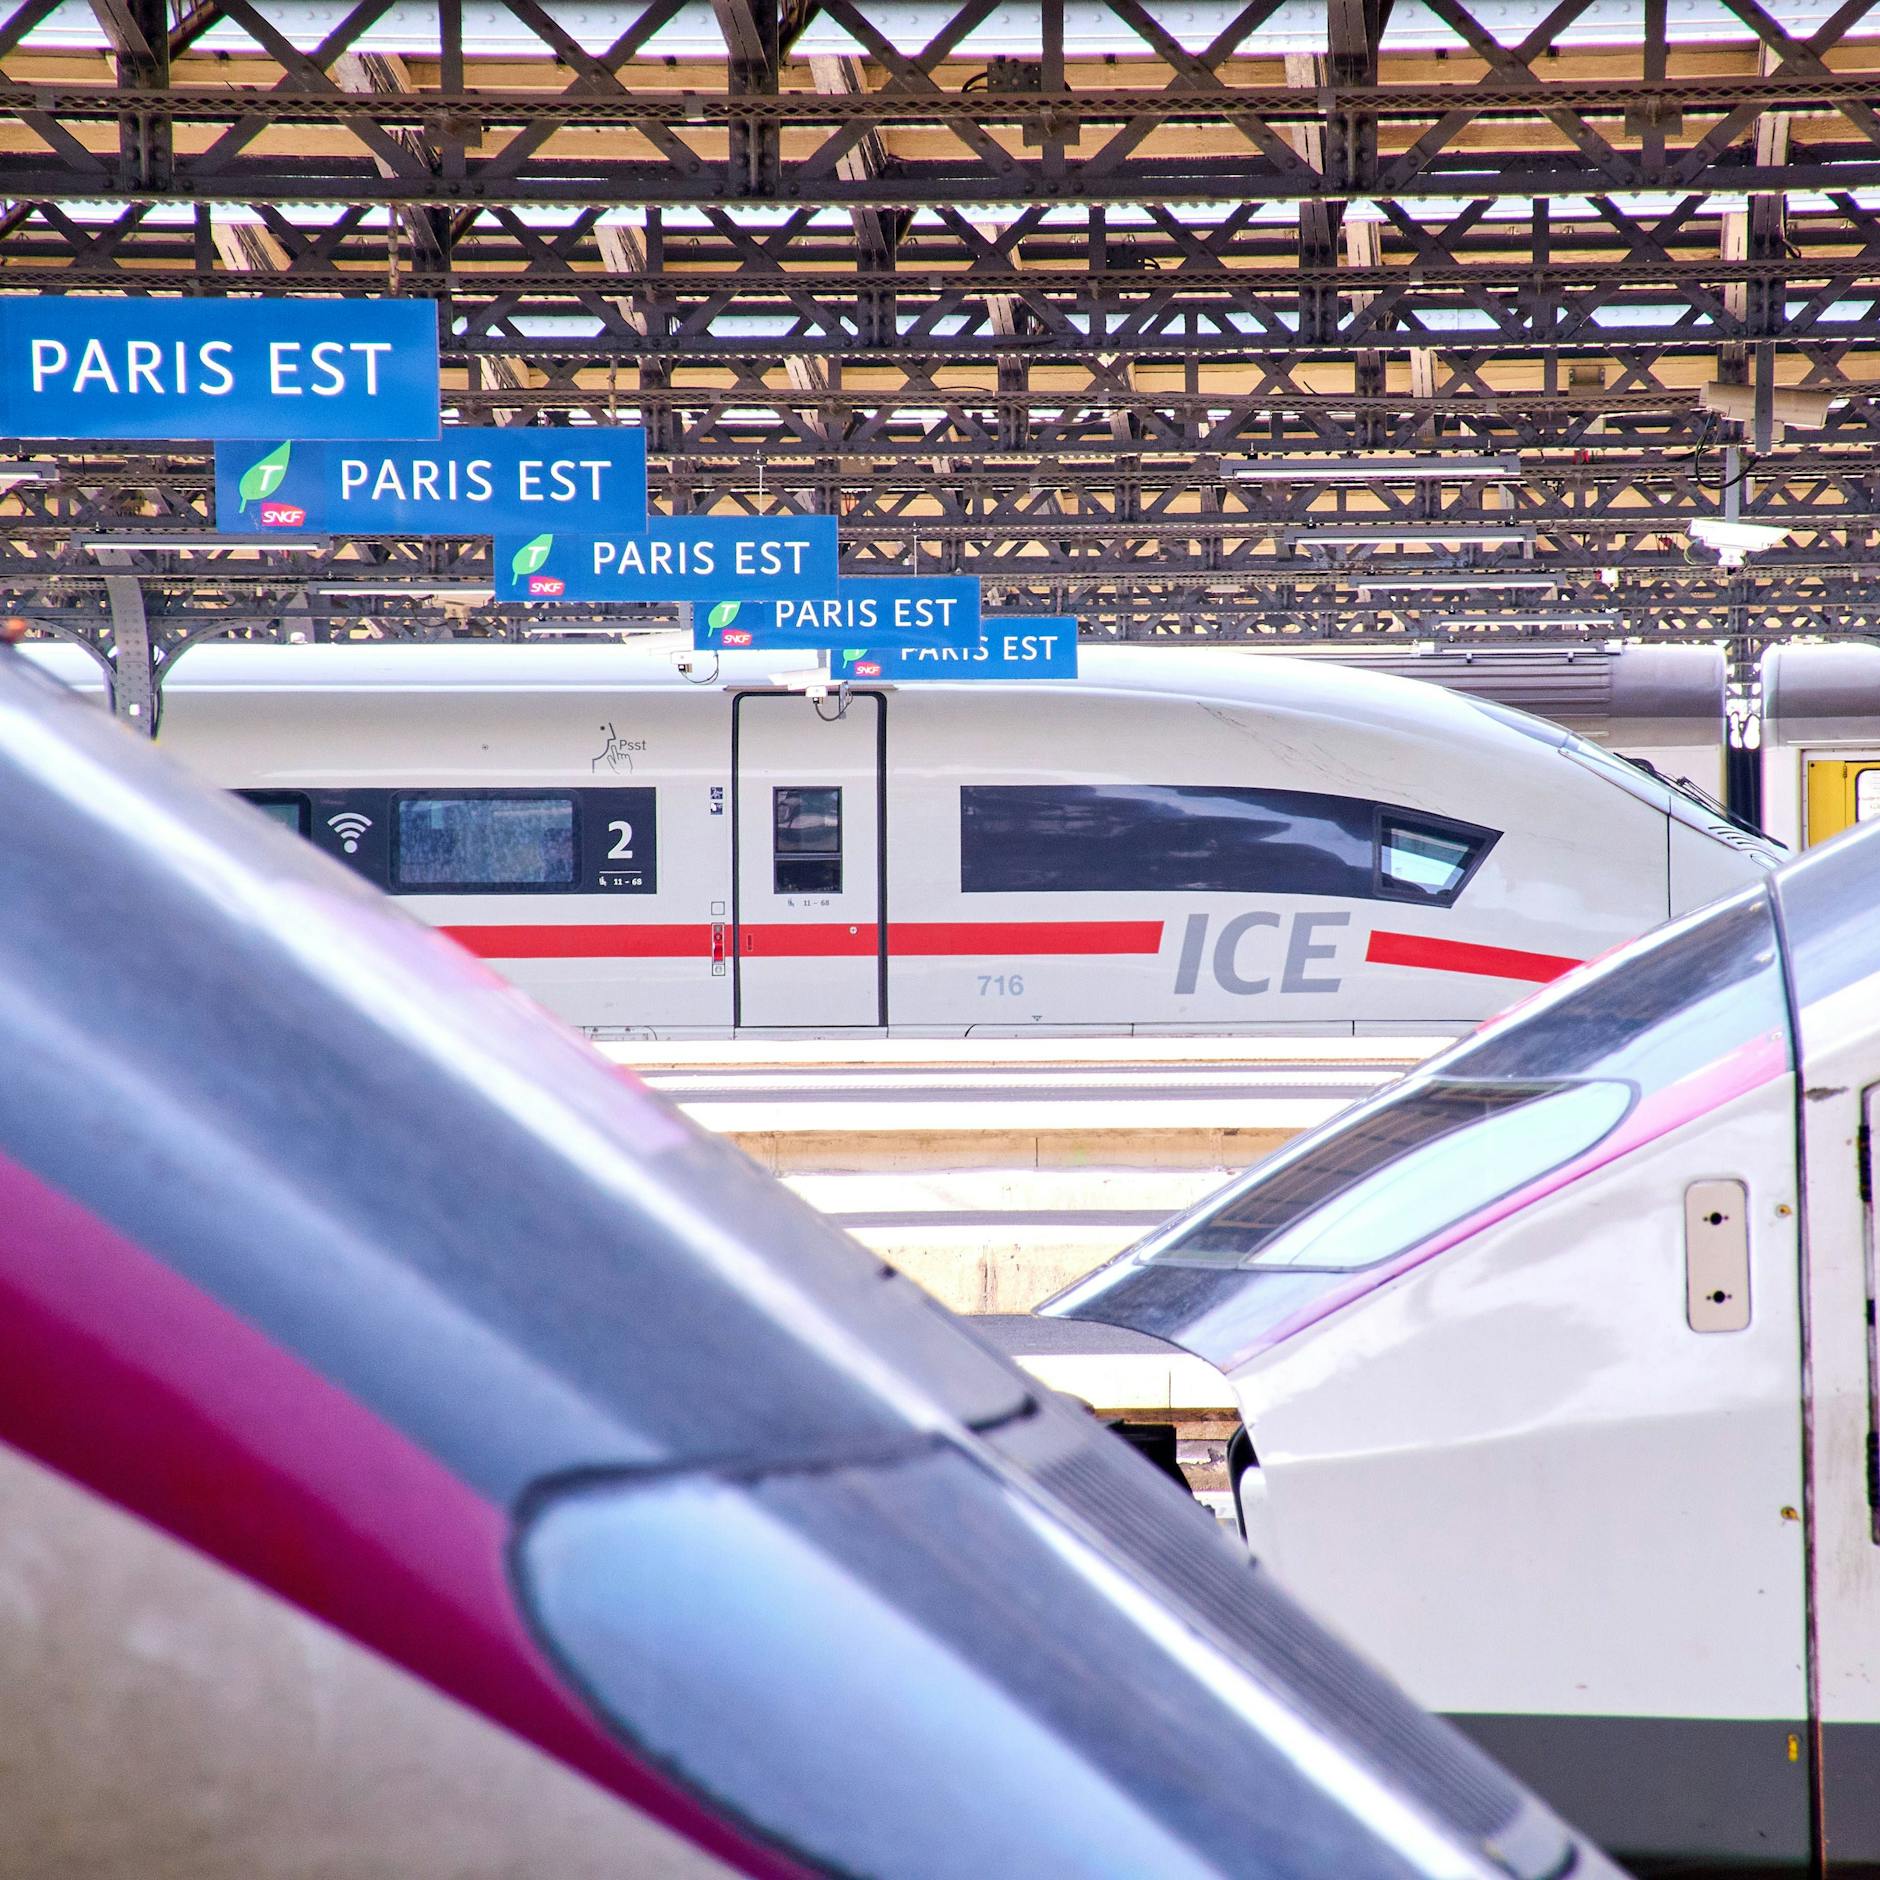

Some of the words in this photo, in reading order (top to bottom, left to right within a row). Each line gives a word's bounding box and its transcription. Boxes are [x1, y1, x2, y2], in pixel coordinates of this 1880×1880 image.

[31, 338, 234, 396] PARIS
[270, 341, 393, 396] EST
[258, 465, 283, 491] T
[341, 459, 493, 502] PARIS
[518, 459, 612, 502] EST
[262, 510, 304, 523] SNCF
[528, 546, 548, 568] T
[593, 541, 715, 575] PARIS
[735, 541, 811, 575] EST
[530, 582, 564, 593] SNCF
[775, 599, 878, 628] PARIS
[895, 599, 958, 628] EST
[723, 634, 751, 644] SNCF
[1003, 636, 1059, 661] EST
[855, 664, 881, 675] SNCF
[619, 739, 647, 751] Psst
[607, 820, 633, 859] 2
[613, 877, 623, 886] 11
[632, 877, 643, 886] 68
[1173, 911, 1352, 996] ICE
[977, 974, 1025, 997] 716
